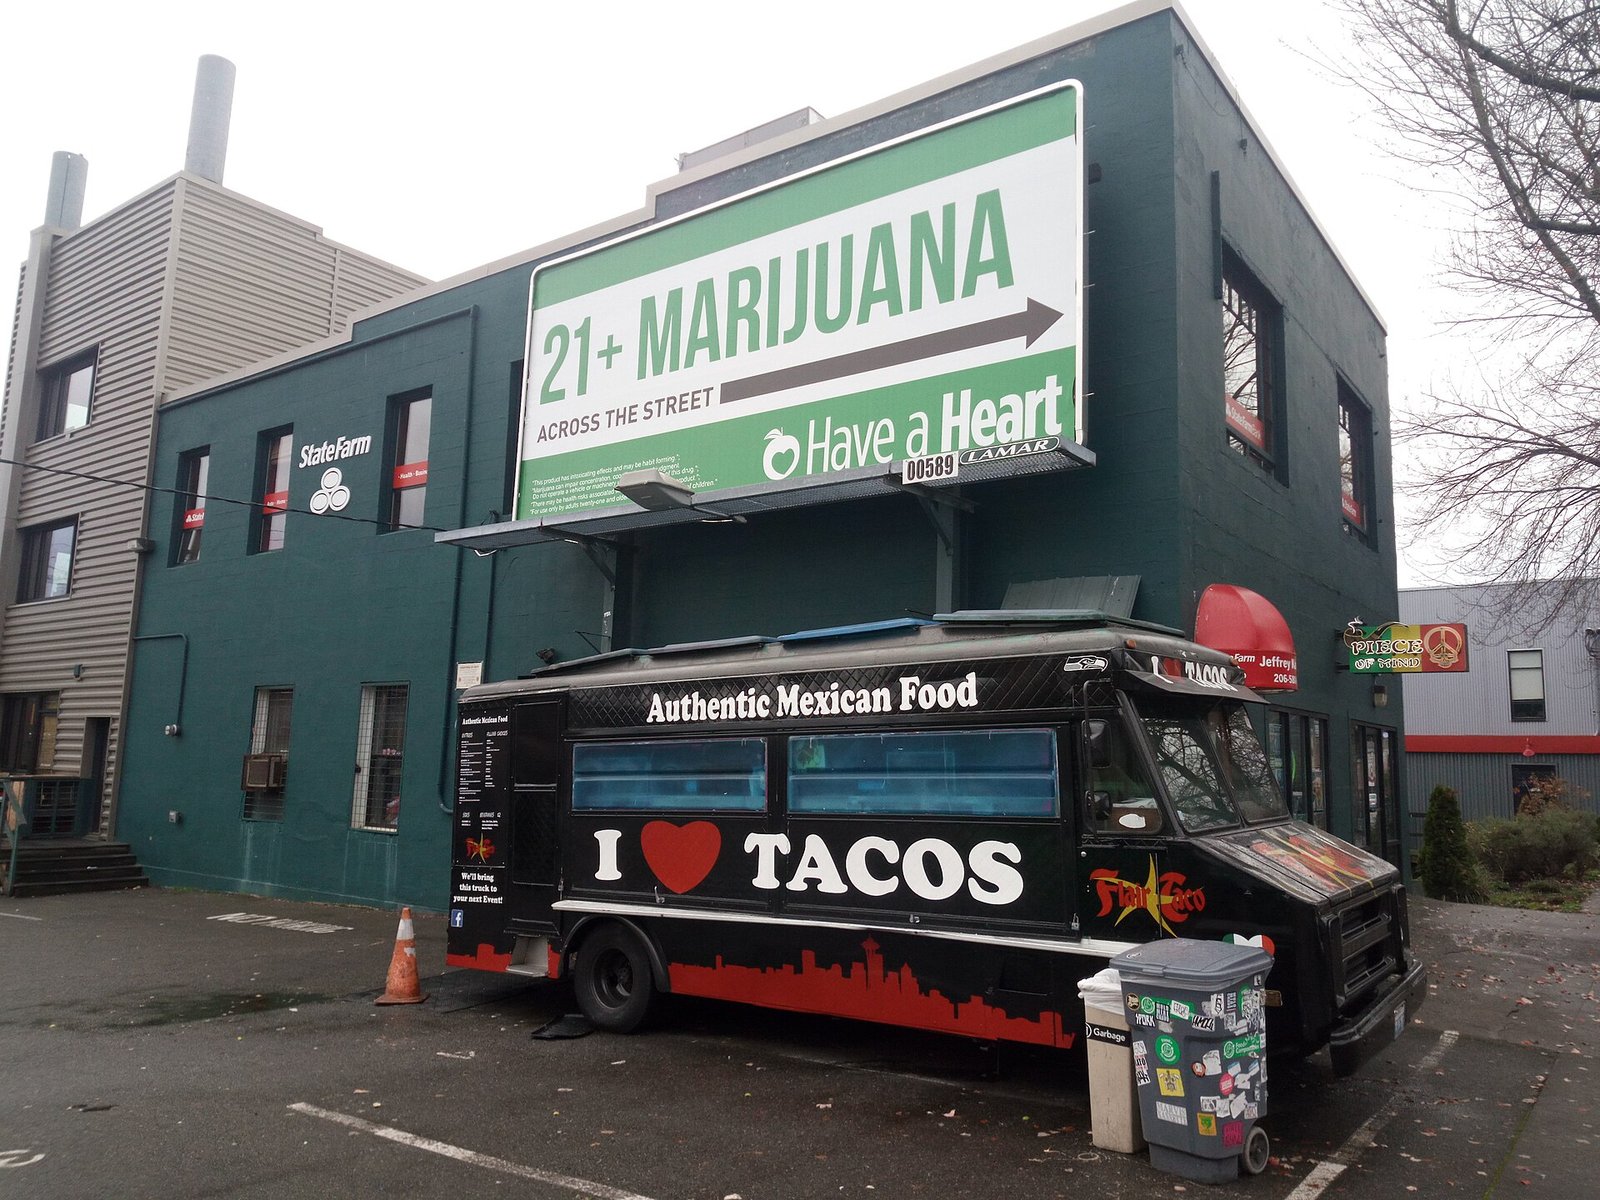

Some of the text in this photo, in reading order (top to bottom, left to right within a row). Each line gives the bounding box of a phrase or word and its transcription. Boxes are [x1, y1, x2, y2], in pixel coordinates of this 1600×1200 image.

[539, 187, 1015, 405] 21+ MARIJUANA
[536, 386, 714, 443] ACROSS THE STREET
[806, 374, 1063, 475] Have a Heart
[967, 439, 1049, 462] LAMAR
[907, 455, 954, 481] 00589
[1351, 639, 1424, 656] PIECE
[1259, 655, 1291, 671] Jeffrey
[1355, 658, 1421, 670] OF MIND
[1185, 661, 1239, 692] TACOS
[646, 671, 979, 724] Authentic Mexican Food
[461, 872, 495, 883] We'll bring
[593, 828, 1024, 905] I TACOS
[459, 883, 471, 891] this
[453, 895, 468, 903] your
[1093, 1027, 1126, 1042] Garbage
